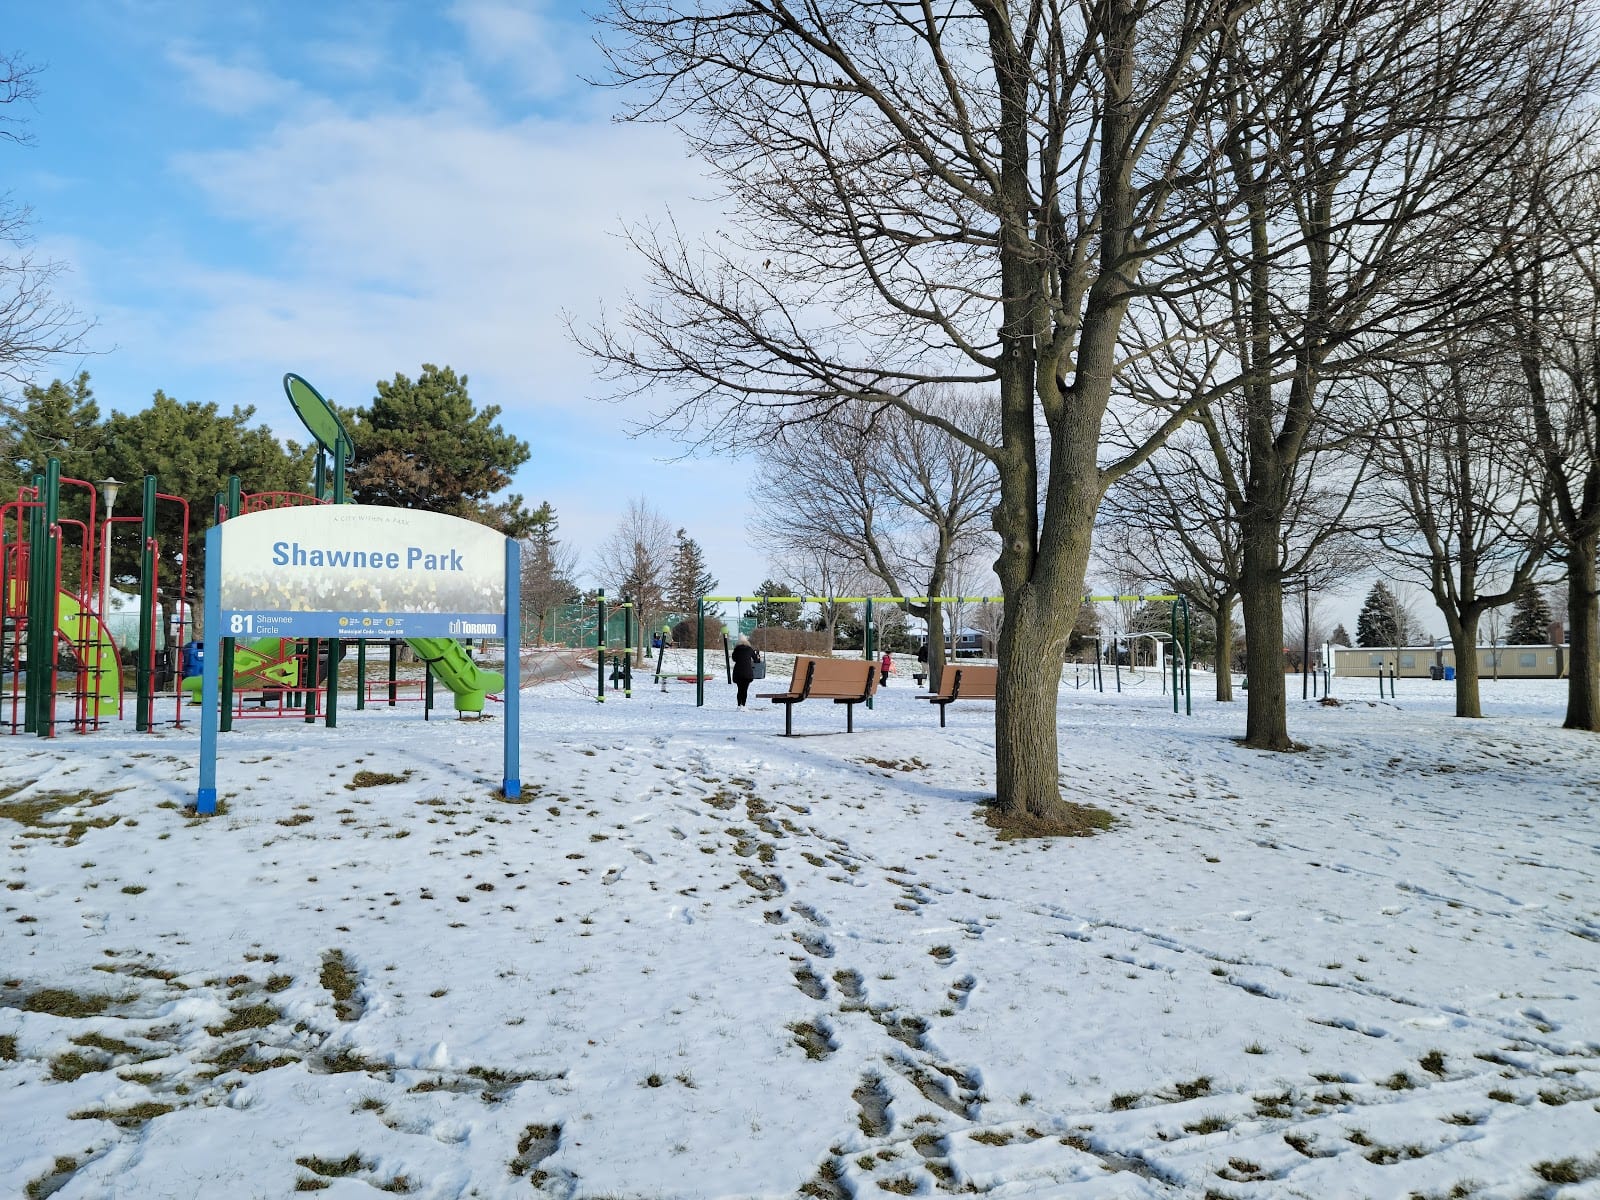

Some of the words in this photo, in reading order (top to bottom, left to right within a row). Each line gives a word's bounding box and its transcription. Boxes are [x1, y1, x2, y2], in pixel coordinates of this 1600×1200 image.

[272, 541, 399, 569] Shawnee
[407, 547, 464, 571] Park
[230, 614, 253, 634] 81
[256, 614, 293, 623] Shawnee
[256, 625, 279, 634] Circle
[462, 621, 497, 634] TORONTO
